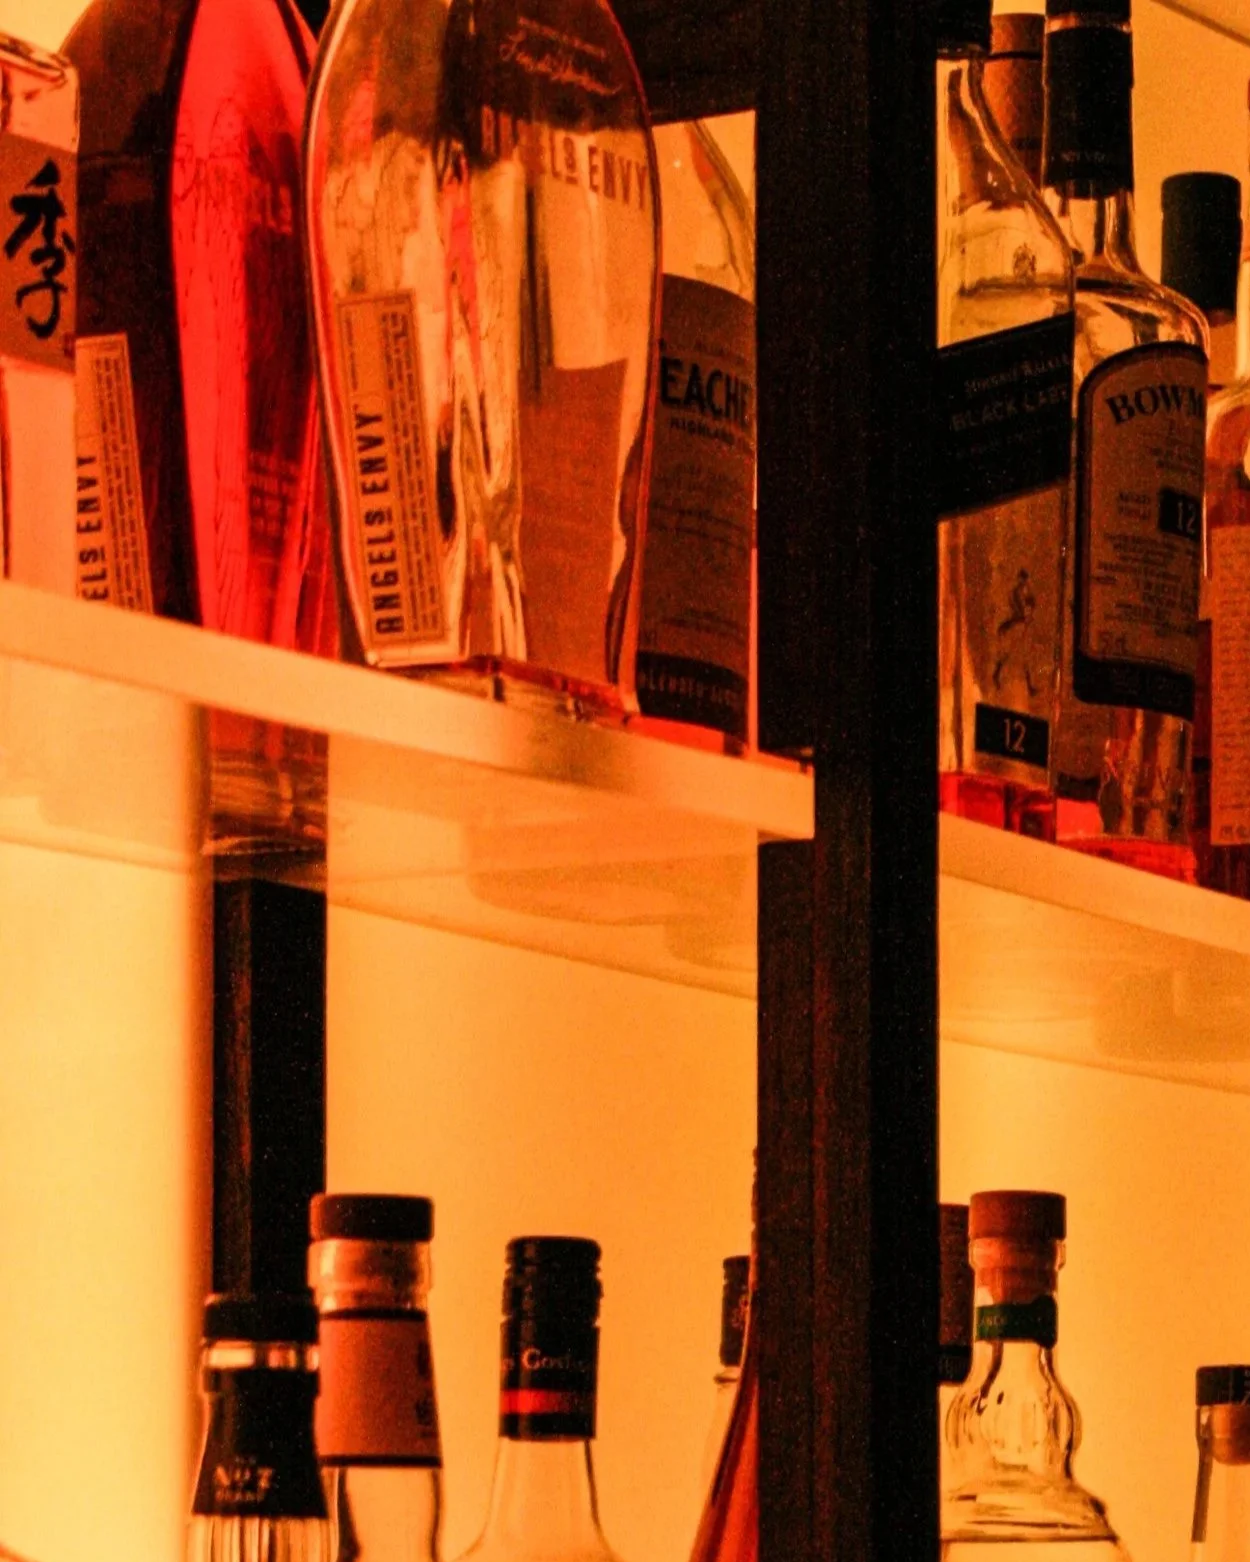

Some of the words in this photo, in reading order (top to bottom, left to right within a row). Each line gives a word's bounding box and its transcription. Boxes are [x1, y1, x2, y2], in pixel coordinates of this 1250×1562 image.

[75, 454, 103, 534] ENVY
[355, 408, 390, 496] ENVY
[364, 507, 406, 635] ANGELS
[1002, 716, 1027, 755] 12
